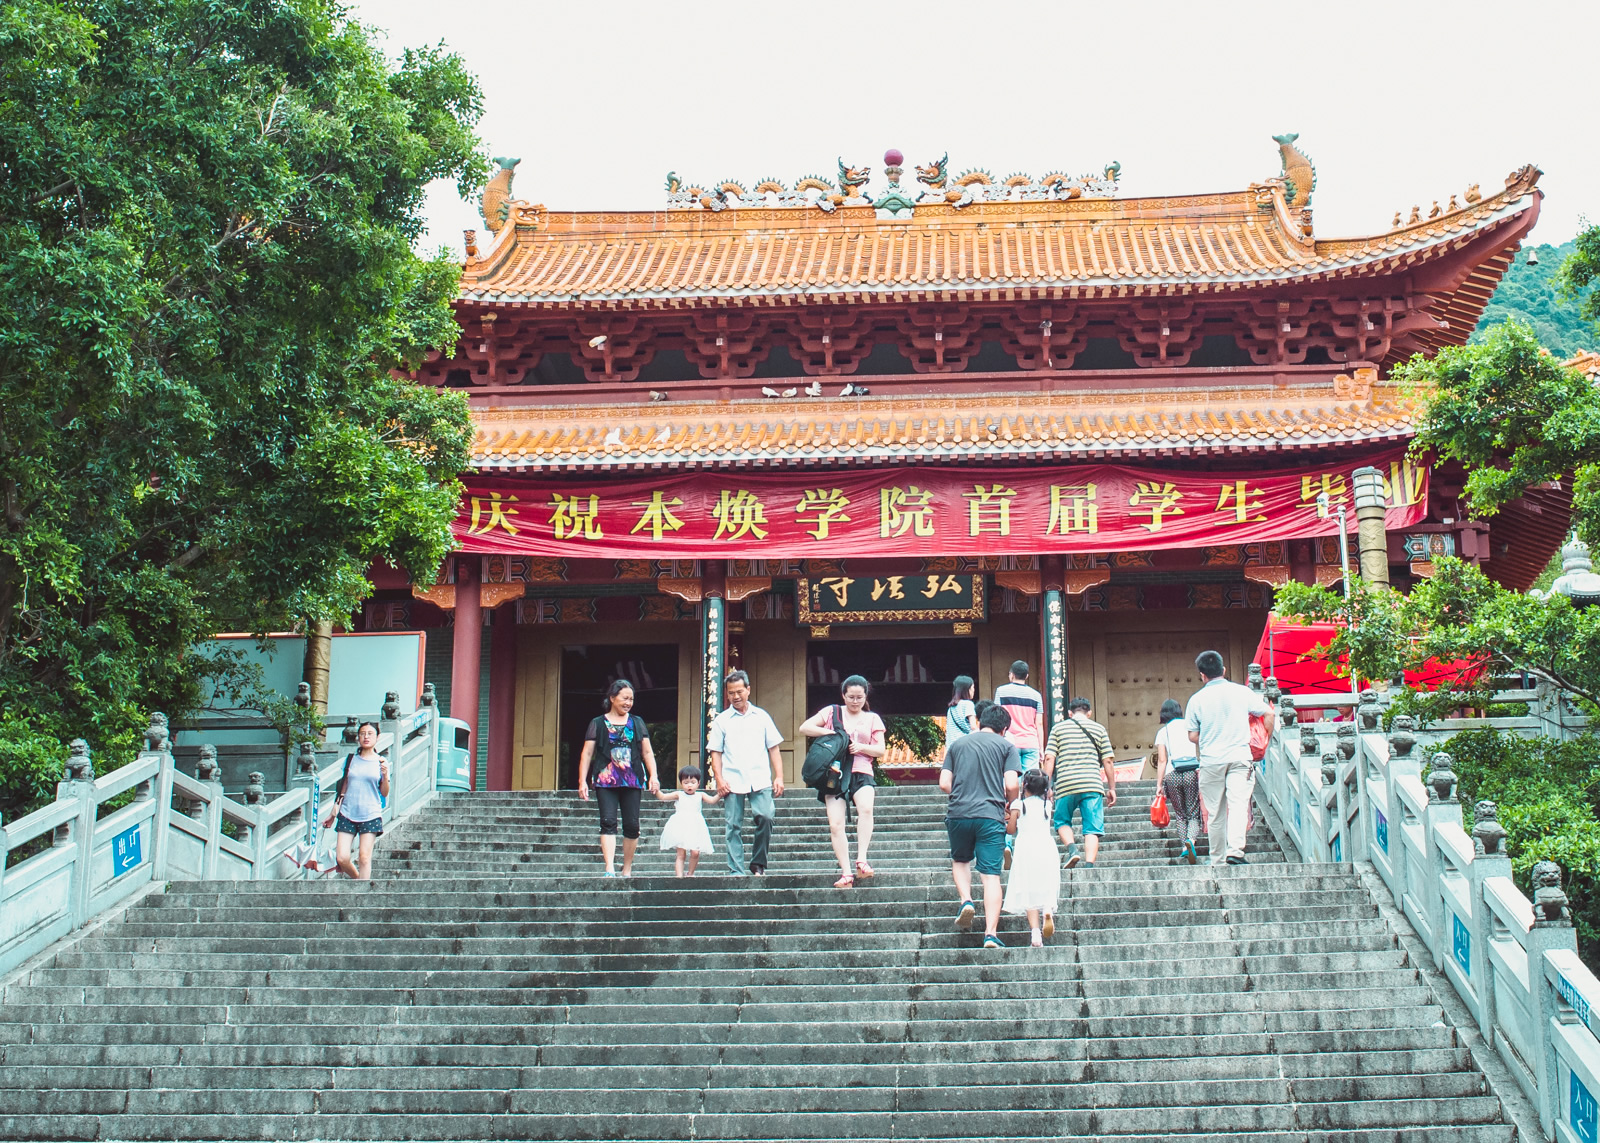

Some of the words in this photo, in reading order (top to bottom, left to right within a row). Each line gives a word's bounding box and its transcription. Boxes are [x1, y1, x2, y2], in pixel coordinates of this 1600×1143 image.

[467, 459, 1426, 541] 庆祝本焕学院首届学生毕业
[1456, 920, 1468, 949] 入口
[1574, 1082, 1593, 1123] 入口
